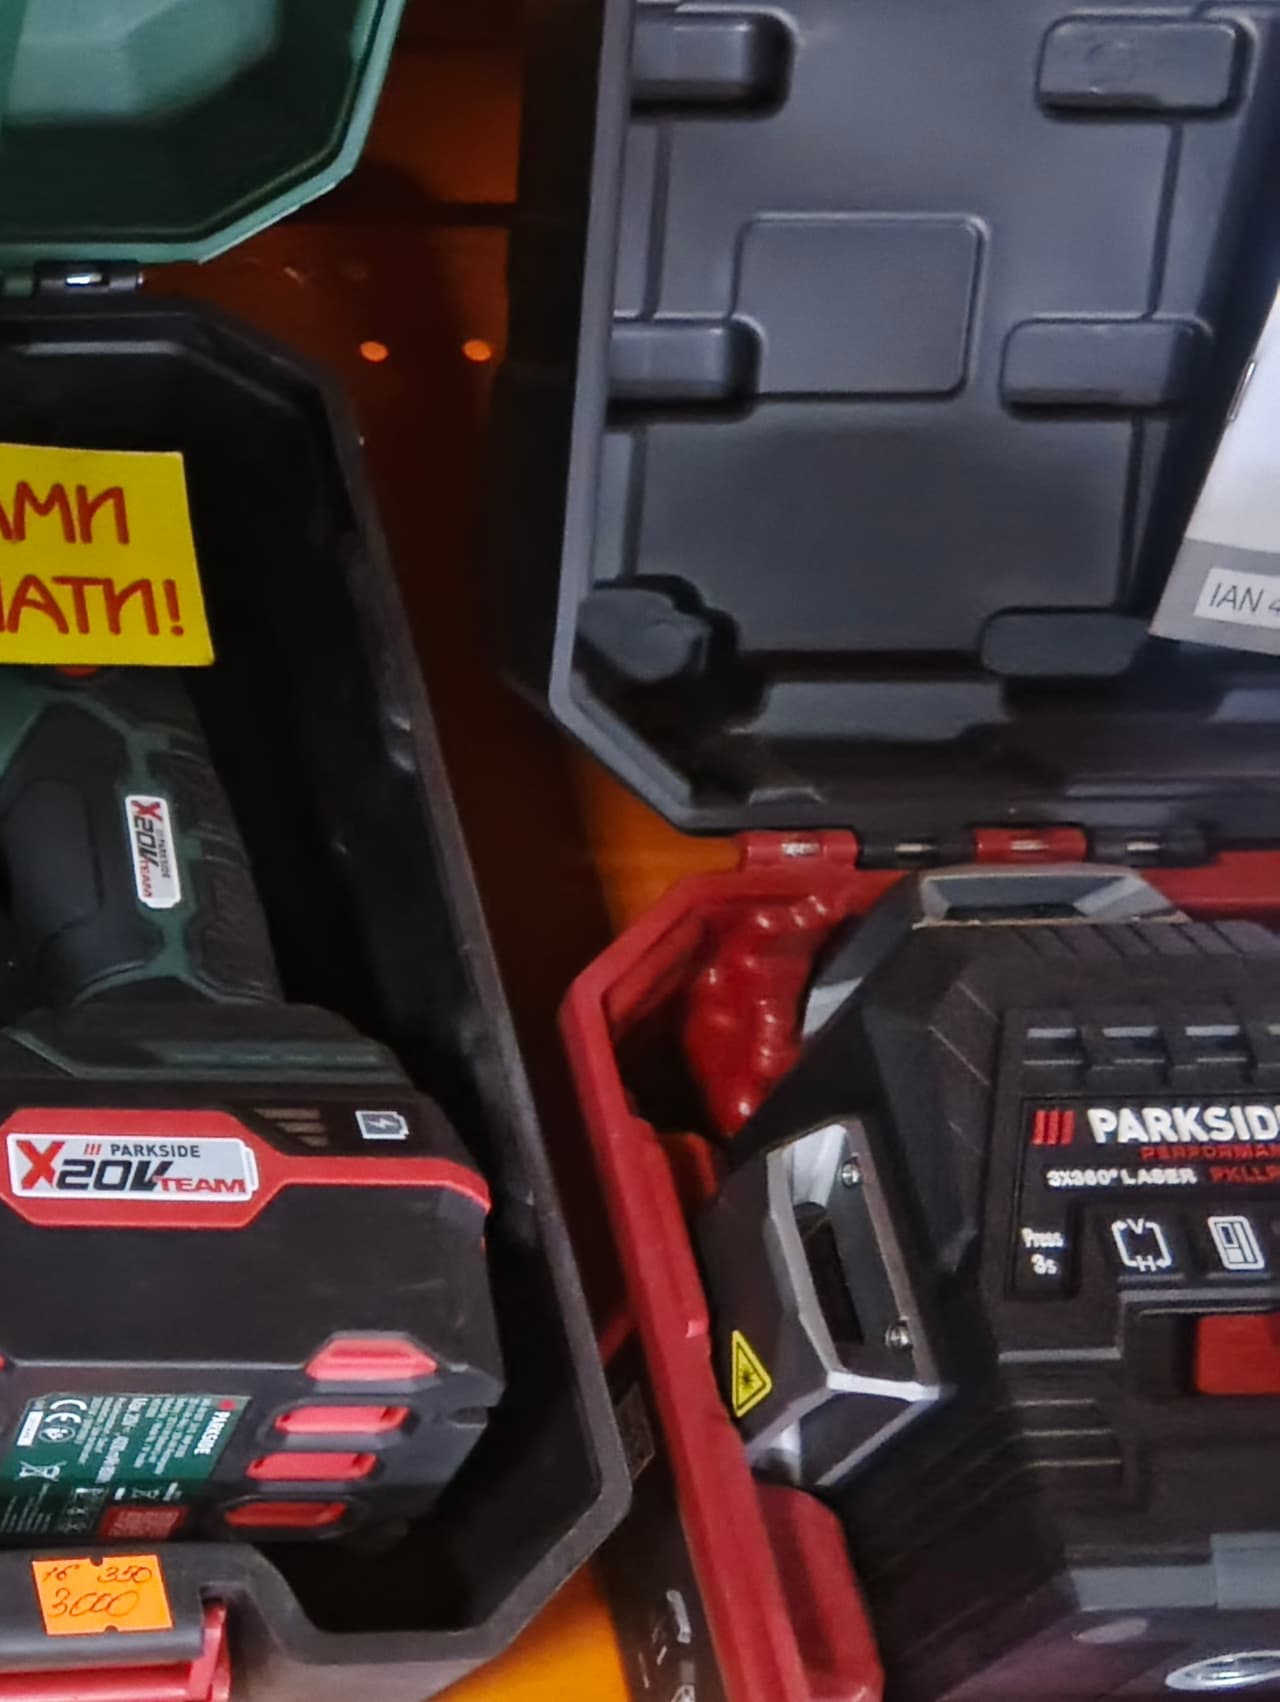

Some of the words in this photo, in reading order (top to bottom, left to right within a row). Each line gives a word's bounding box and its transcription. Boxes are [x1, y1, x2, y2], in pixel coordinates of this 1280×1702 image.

[1209, 580, 1264, 613] IAN
[1088, 1106, 1280, 1143] PARKSID
[111, 1143, 201, 1158] PARKSIDE
[157, 1177, 246, 1193] TEAM
[1121, 1167, 1198, 1185] LASER
[1021, 1227, 1065, 1248] Press
[1030, 1253, 1058, 1275] 3s
